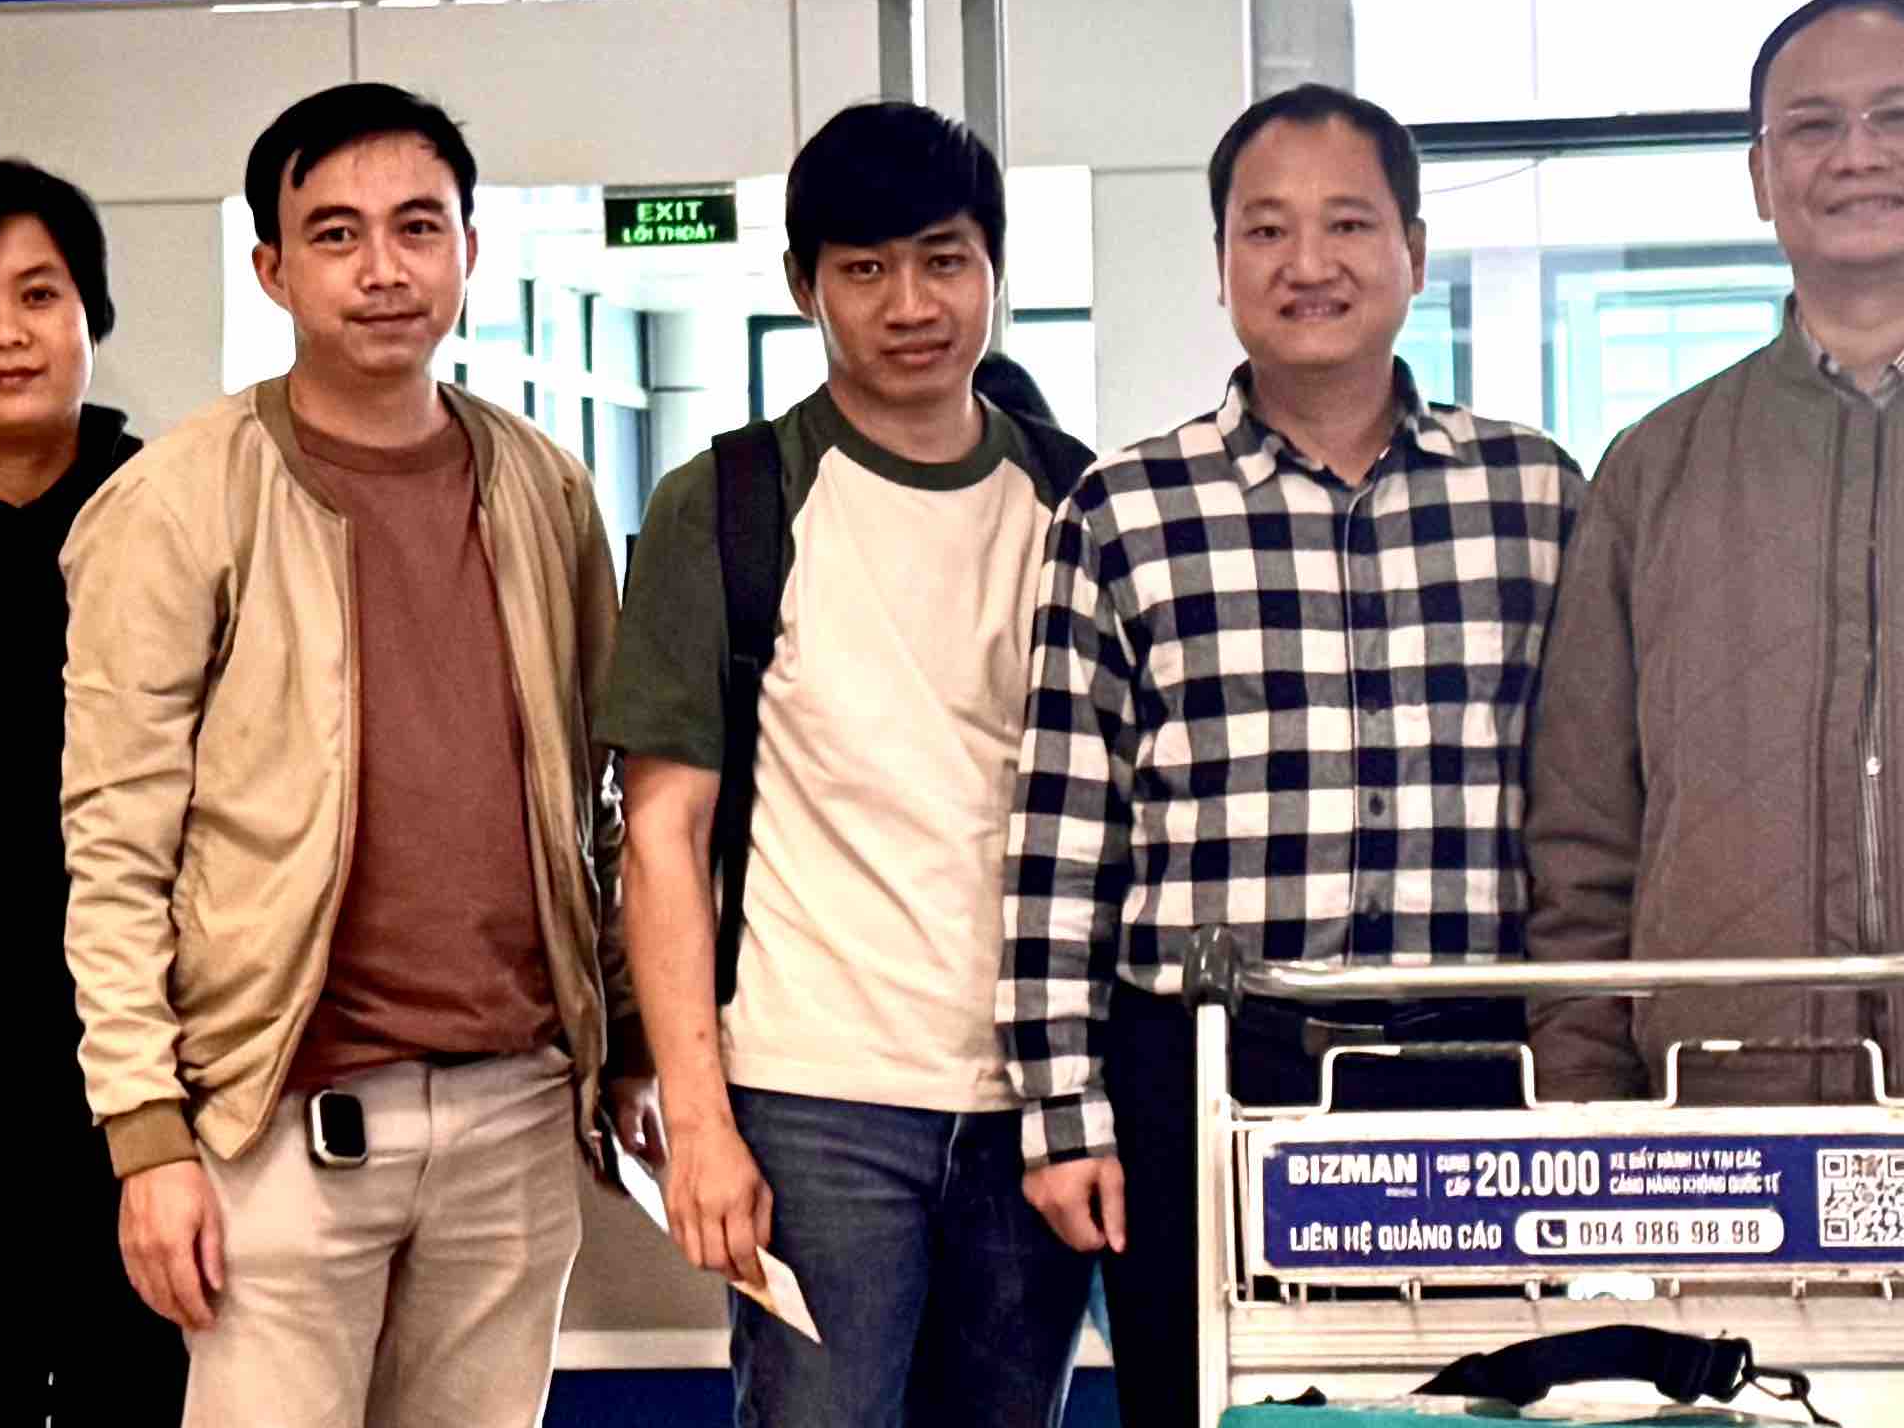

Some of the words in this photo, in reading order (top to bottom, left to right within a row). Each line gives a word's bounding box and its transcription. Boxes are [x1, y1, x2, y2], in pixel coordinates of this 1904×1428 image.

[637, 200, 703, 222] EXIT
[1288, 1153, 1417, 1185] BIZMAN
[1475, 1150, 1600, 1197] 20.000
[1290, 1221, 1337, 1252] LIÊN
[1378, 1217, 1452, 1251] QUẢNG
[1457, 1220, 1502, 1250] CÁO
[1579, 1221, 1624, 1246] 094
[1690, 1220, 1720, 1245] 98
[1732, 1220, 1761, 1245] 98
